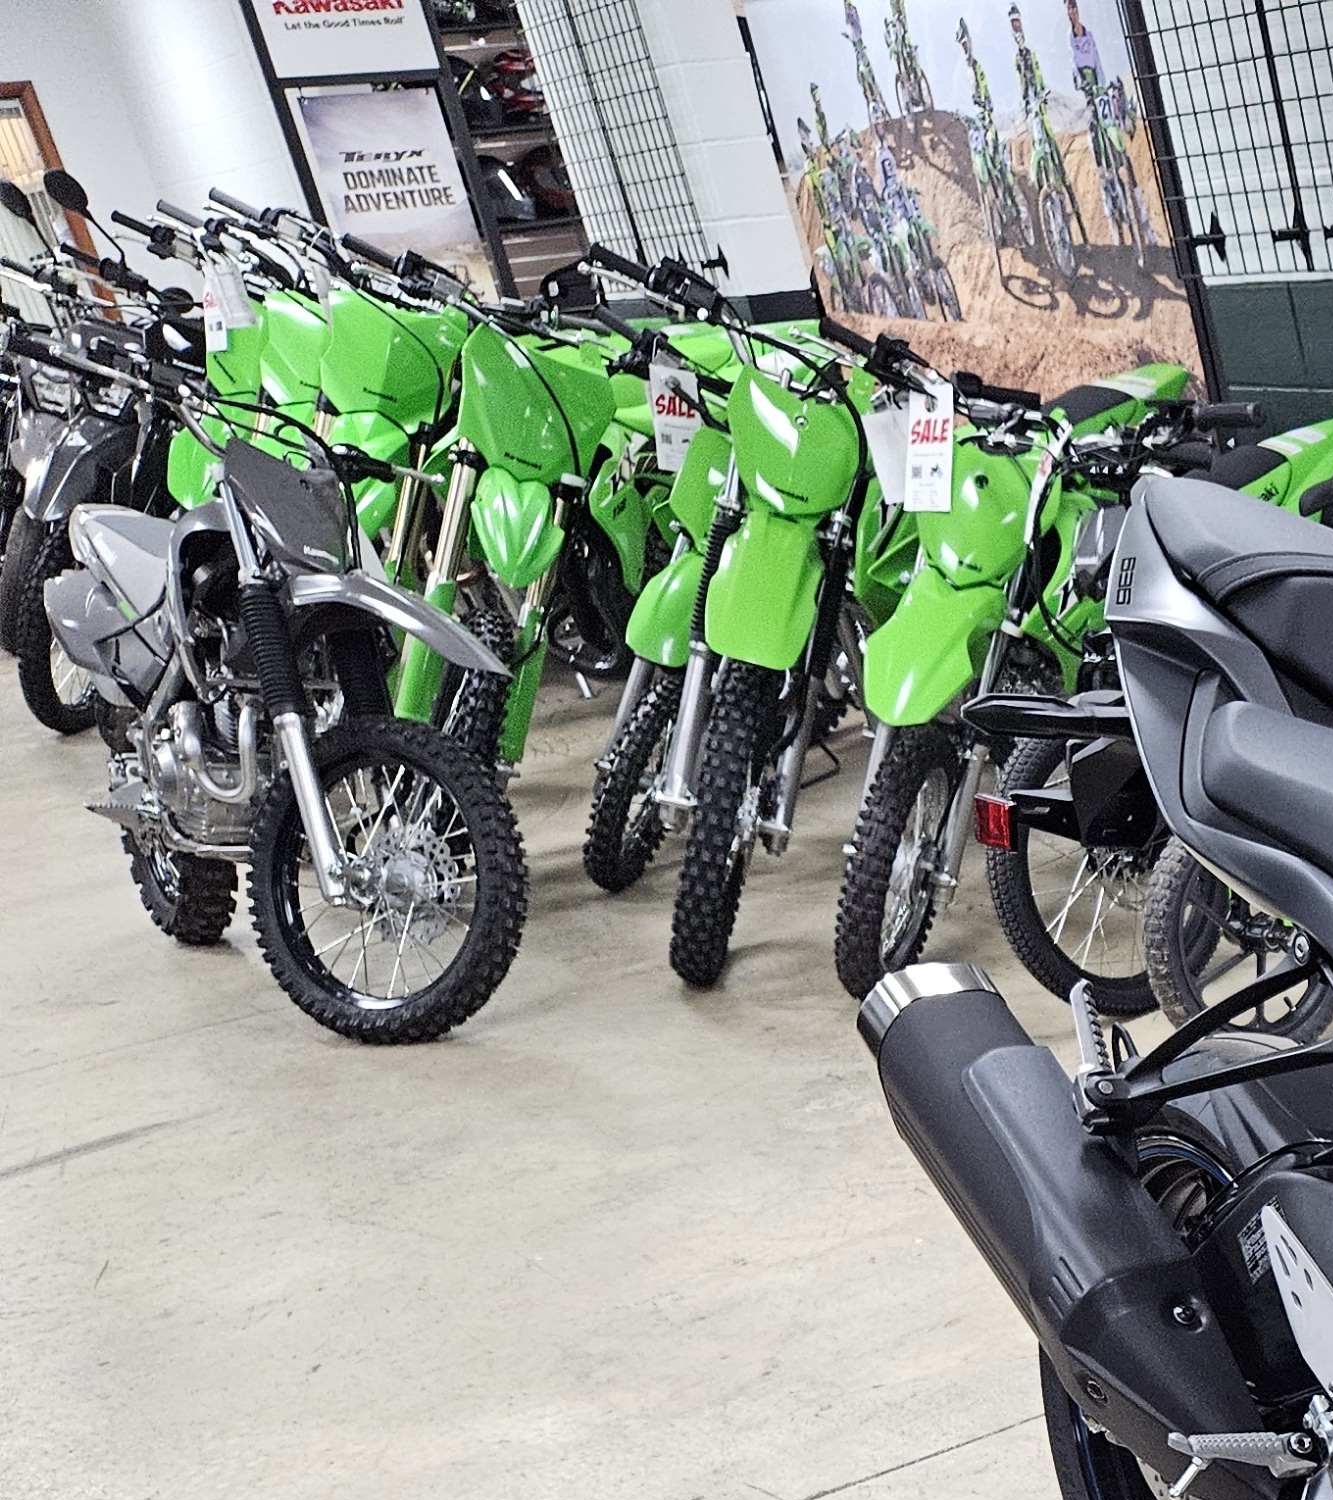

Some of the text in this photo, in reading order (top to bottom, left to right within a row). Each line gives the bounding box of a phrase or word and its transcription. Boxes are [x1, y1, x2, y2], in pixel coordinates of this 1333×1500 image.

[284, 20, 302, 31] Let
[303, 19, 321, 30] the
[322, 18, 349, 29] Good
[352, 17, 381, 28] Times
[343, 164, 442, 191] DOMINATE
[344, 186, 457, 213] ADVENTURE
[655, 393, 696, 419] SALE
[910, 418, 950, 446] SALE
[1116, 557, 1136, 605] 636
